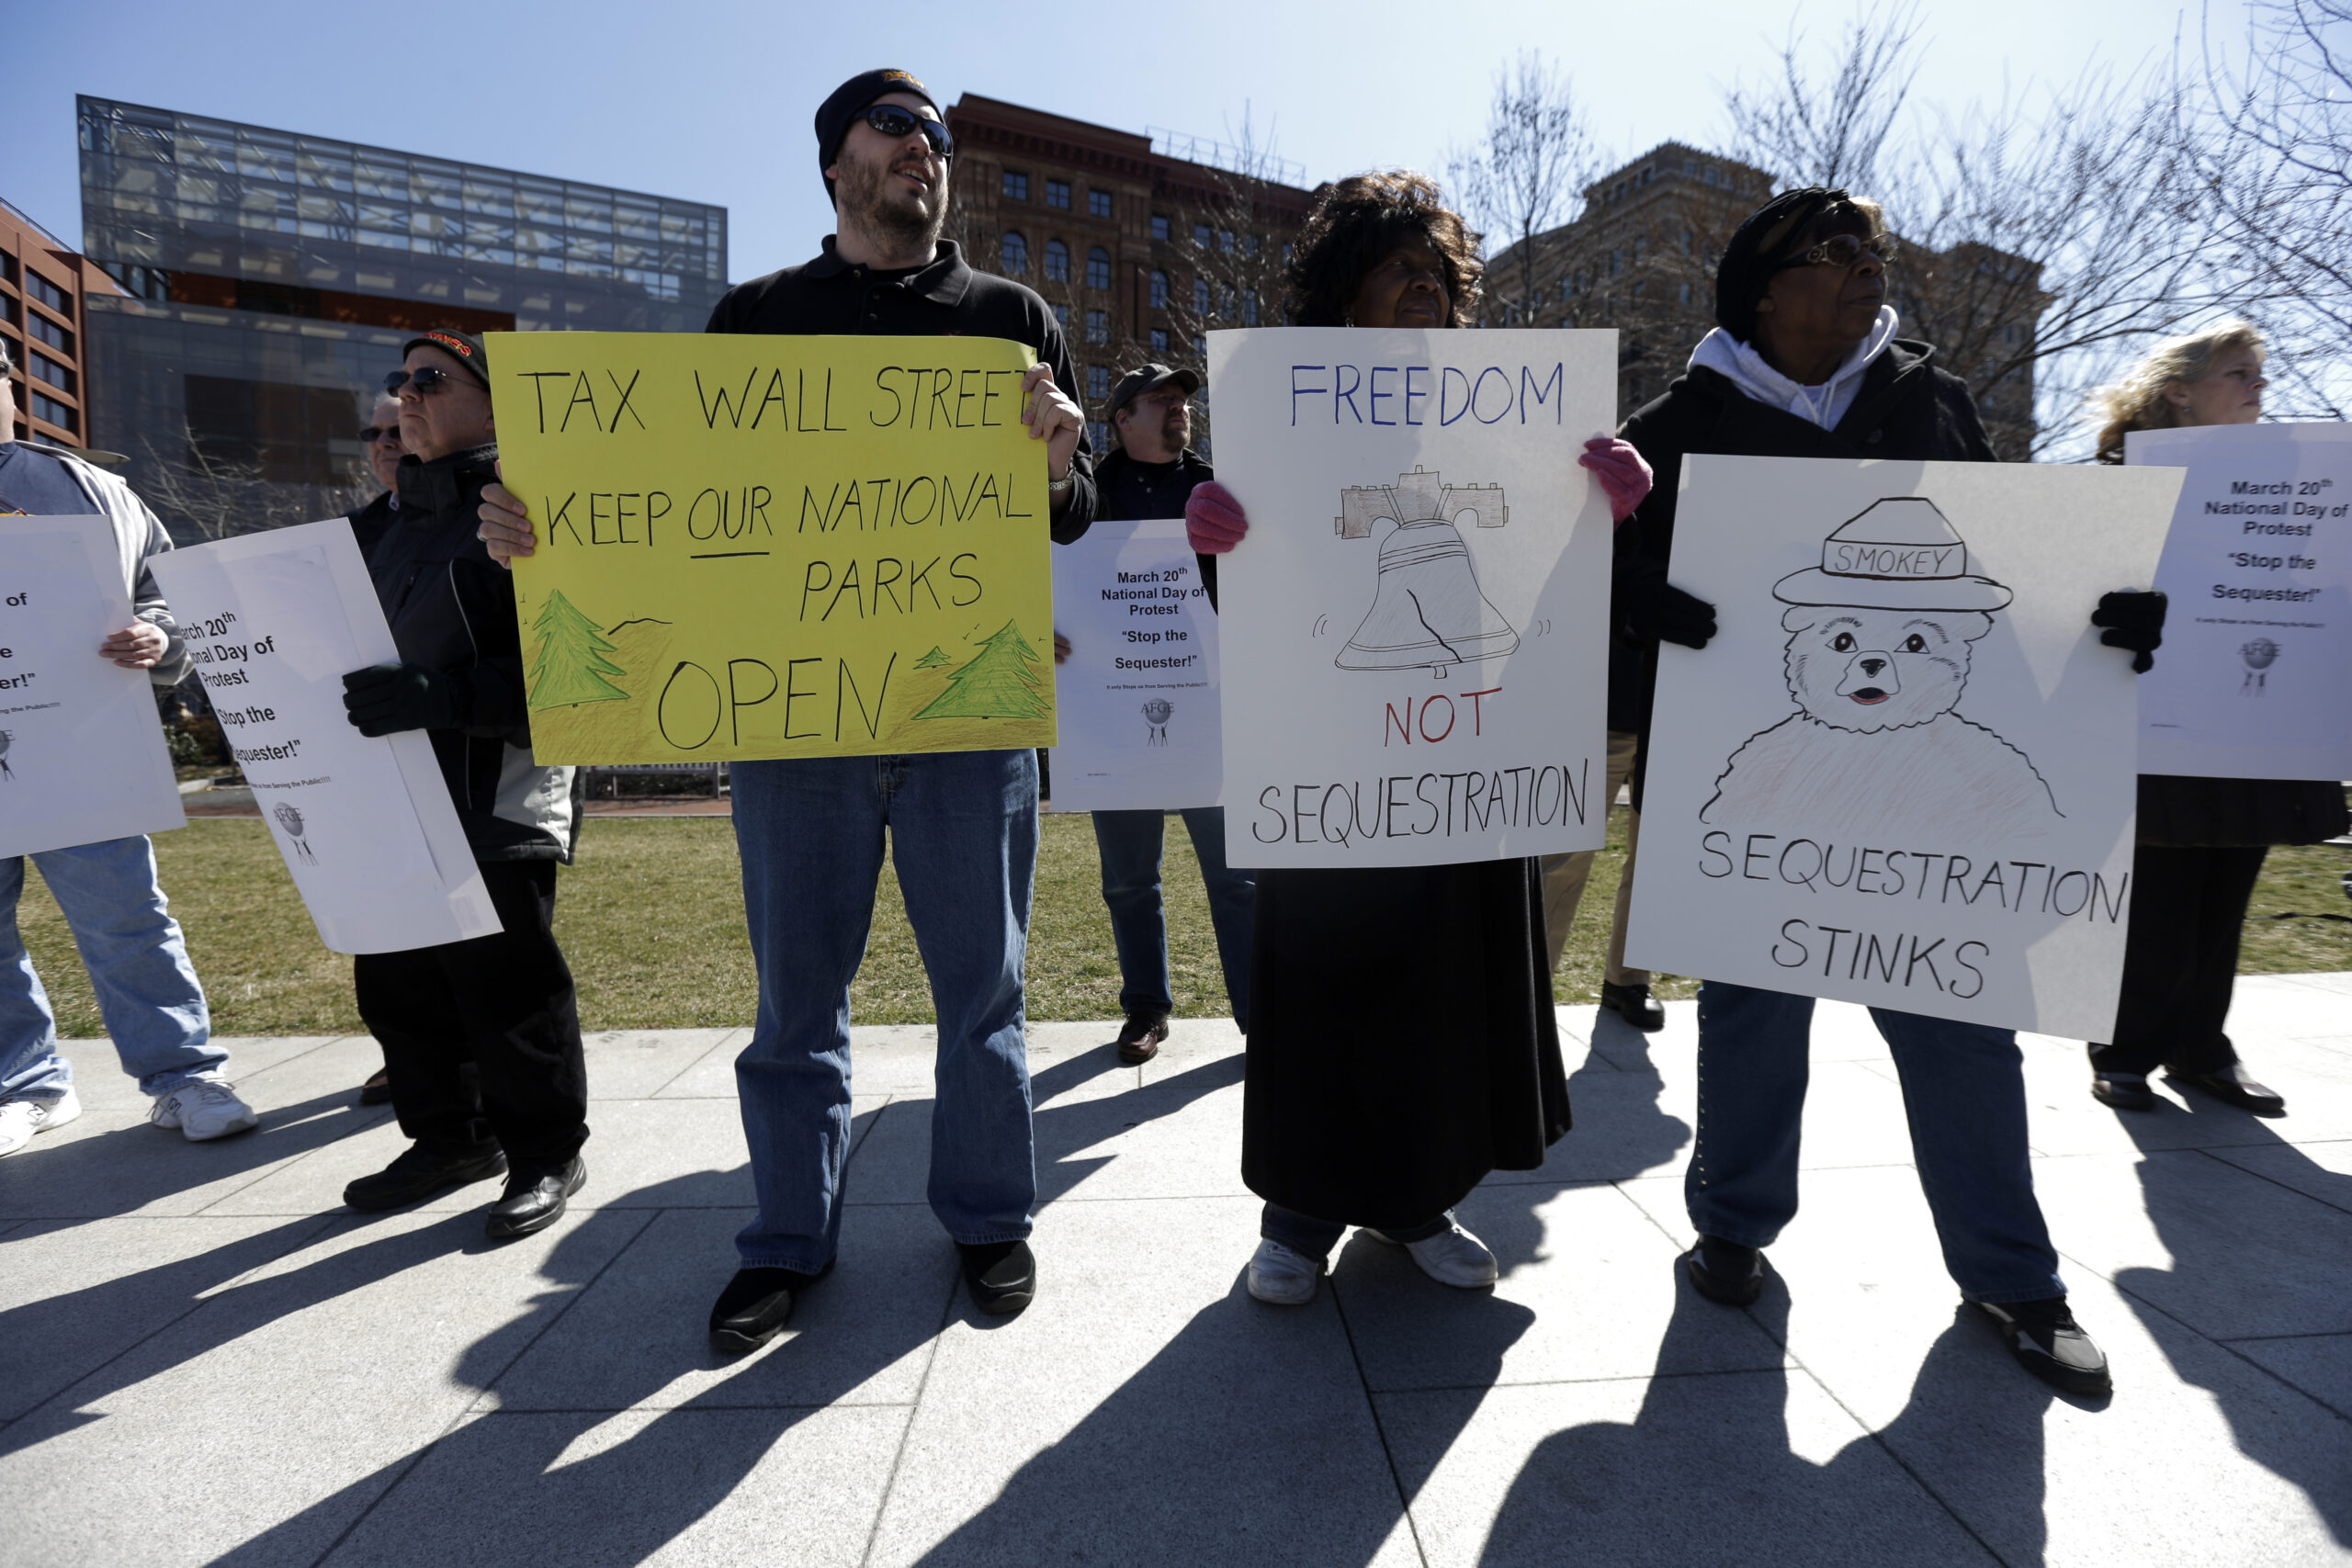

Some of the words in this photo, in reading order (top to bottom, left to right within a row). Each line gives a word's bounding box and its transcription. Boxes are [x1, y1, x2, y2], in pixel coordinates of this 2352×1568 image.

[516, 368, 646, 434] TAX
[694, 367, 847, 433] WALL
[1292, 362, 1564, 427] FREEDOM
[2231, 480, 2292, 496] March
[2298, 478, 2334, 496] 20th
[545, 491, 673, 547] KEEP
[687, 485, 773, 540] OUR
[798, 471, 1034, 534] NATIONAL
[2204, 501, 2288, 516] National
[2292, 502, 2328, 520] Day
[2332, 503, 2349, 518] of
[2243, 521, 2312, 536] Protest
[1835, 545, 1953, 575] SMOKEY
[2228, 552, 2283, 571] “Stop
[2288, 553, 2316, 570] the
[1117, 571, 1159, 584] March
[1162, 566, 1188, 582] 20th
[799, 553, 982, 622] PARKS
[1102, 587, 1158, 601] National
[1161, 586, 1188, 602] Day
[1192, 584, 1205, 598] of
[6, 592, 28, 606] of
[1129, 603, 1179, 616] Protest
[181, 623, 206, 641] arch
[205, 611, 236, 637] 20th
[1122, 630, 1161, 645] “Stop
[1164, 628, 1188, 642] the
[189, 646, 215, 665] onal
[214, 644, 248, 662] Day
[254, 636, 275, 655] of
[1114, 654, 1197, 671] Sequester!”
[201, 669, 249, 688] Protest
[658, 651, 898, 750] OPEN
[1140, 702, 1175, 714] AFGE
[245, 705, 277, 724] the
[1384, 686, 1503, 747] NOT
[232, 739, 300, 765] equester!”
[1252, 758, 1589, 849] SEQUESTRATION
[273, 807, 305, 822] AFGE
[1699, 830, 2129, 924] SEQUESTRATION
[1771, 919, 1990, 999] STINKS
